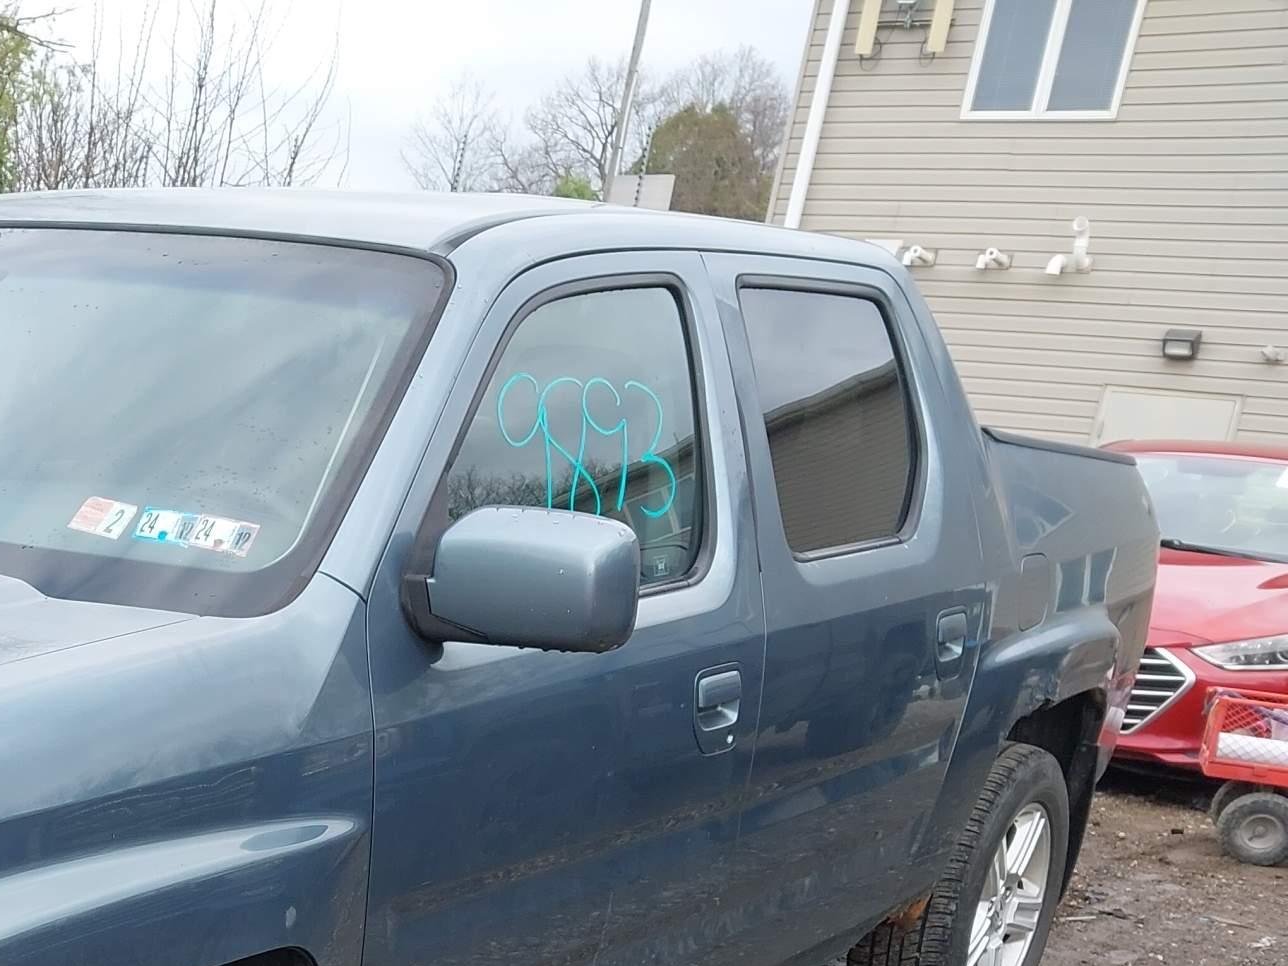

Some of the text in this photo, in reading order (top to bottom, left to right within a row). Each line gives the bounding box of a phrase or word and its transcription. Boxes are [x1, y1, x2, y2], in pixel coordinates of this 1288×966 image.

[497, 372, 676, 518] 9893
[103, 509, 125, 533] 2
[140, 512, 160, 534] 24
[195, 519, 216, 542] 24
